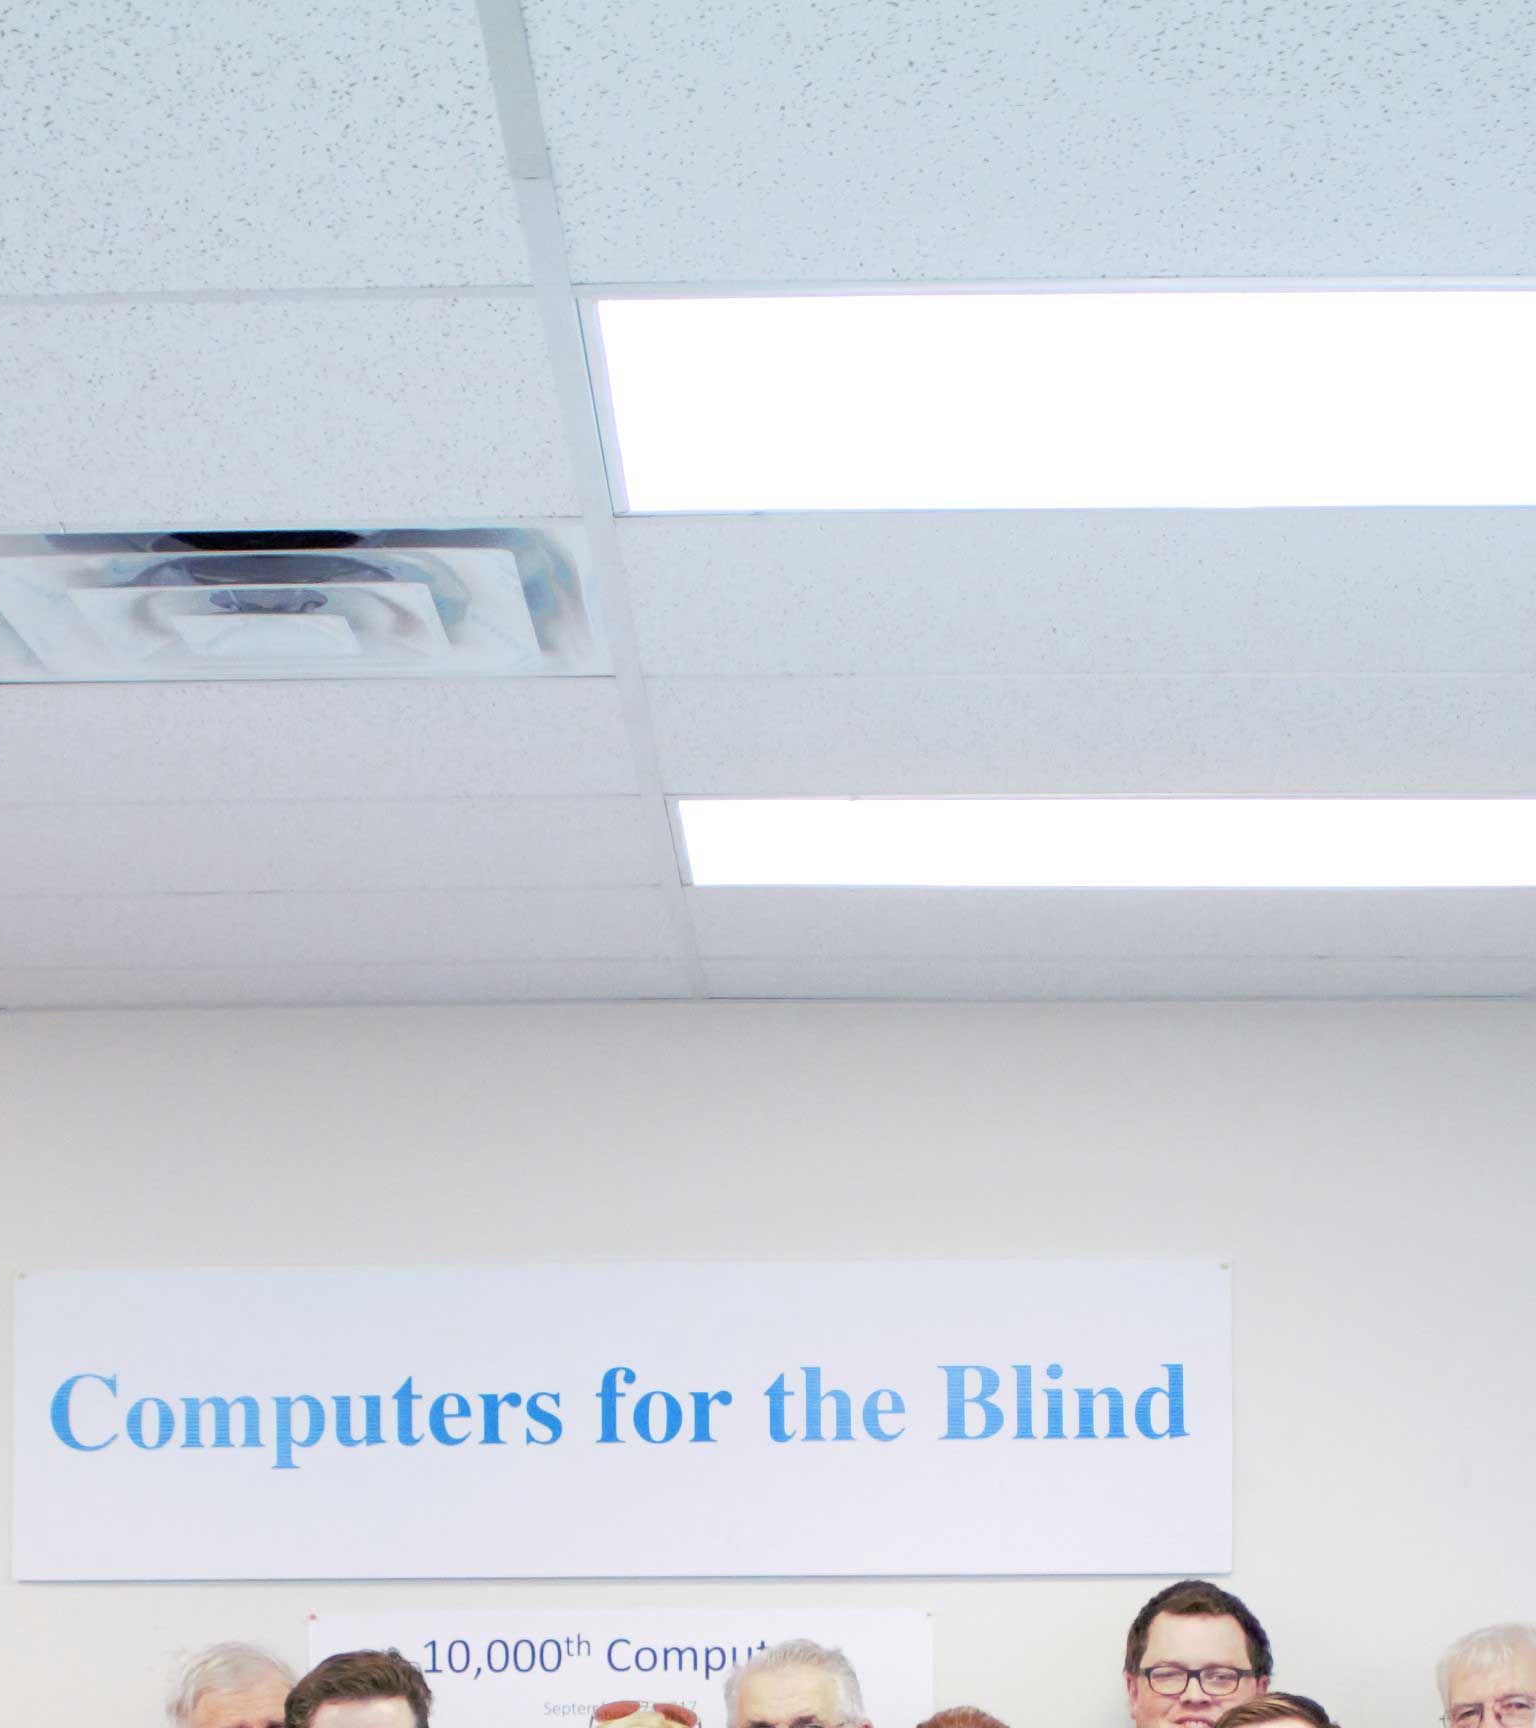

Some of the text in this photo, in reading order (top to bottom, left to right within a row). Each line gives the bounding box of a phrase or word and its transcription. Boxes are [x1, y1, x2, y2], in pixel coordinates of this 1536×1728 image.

[49, 1362, 1190, 1470] Computers for the Blind
[422, 1633, 592, 1680] 10,000th
